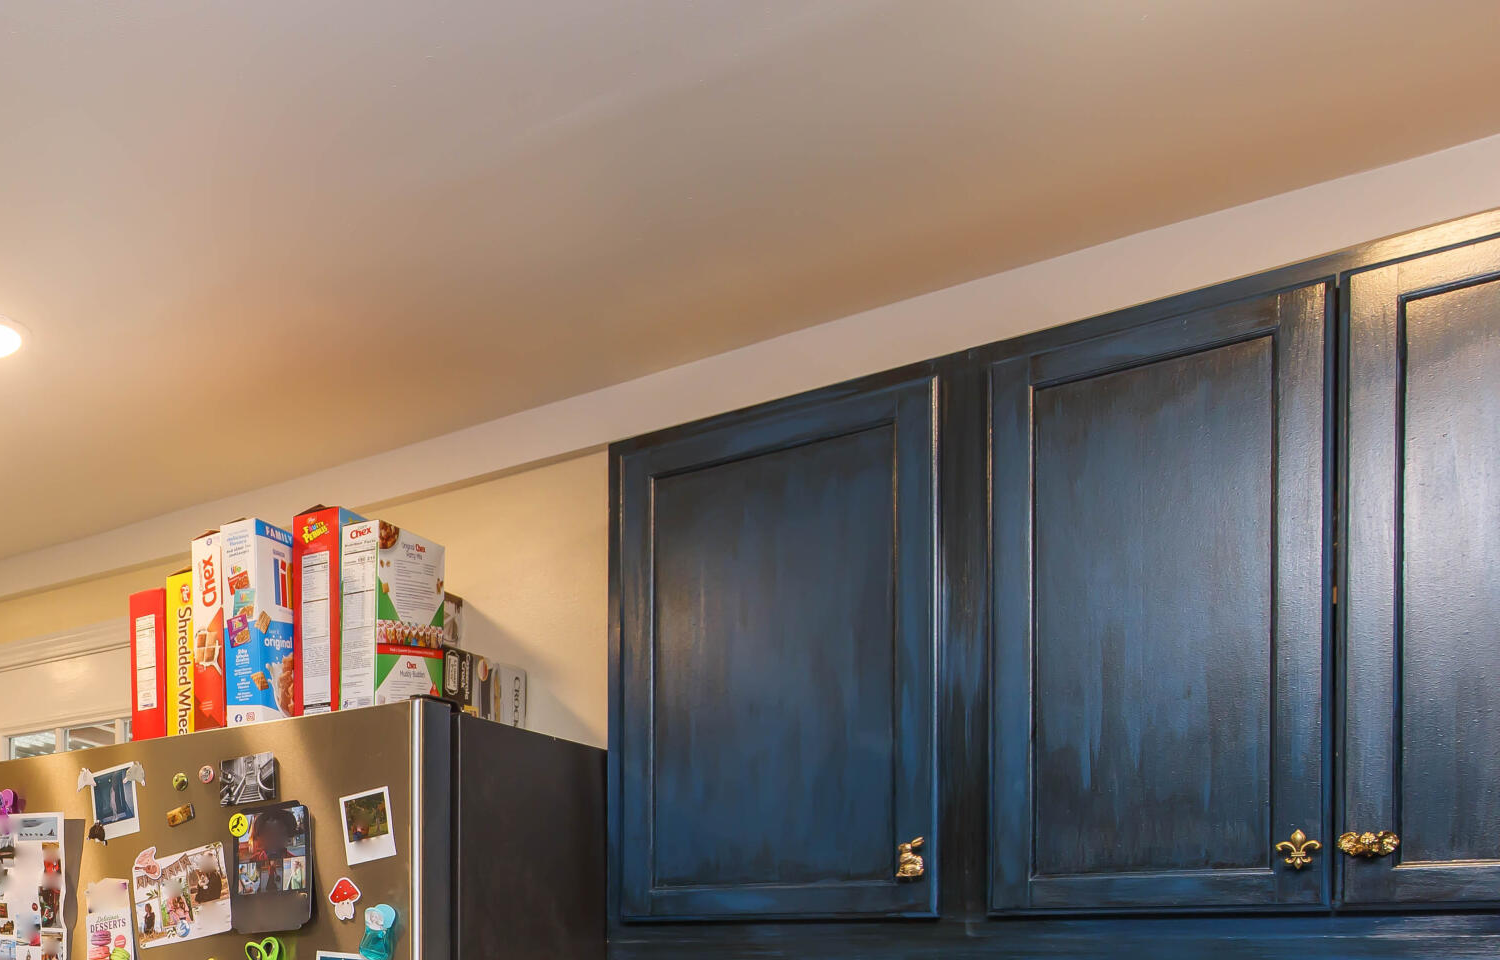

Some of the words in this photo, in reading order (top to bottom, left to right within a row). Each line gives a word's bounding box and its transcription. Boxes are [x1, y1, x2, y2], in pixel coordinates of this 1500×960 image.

[349, 527, 372, 539] Chex
[202, 555, 217, 607] Chex
[178, 606, 192, 686] Shredded
[264, 635, 293, 650] original
[178, 687, 192, 735] Whea
[90, 918, 126, 934] DESSERTS
